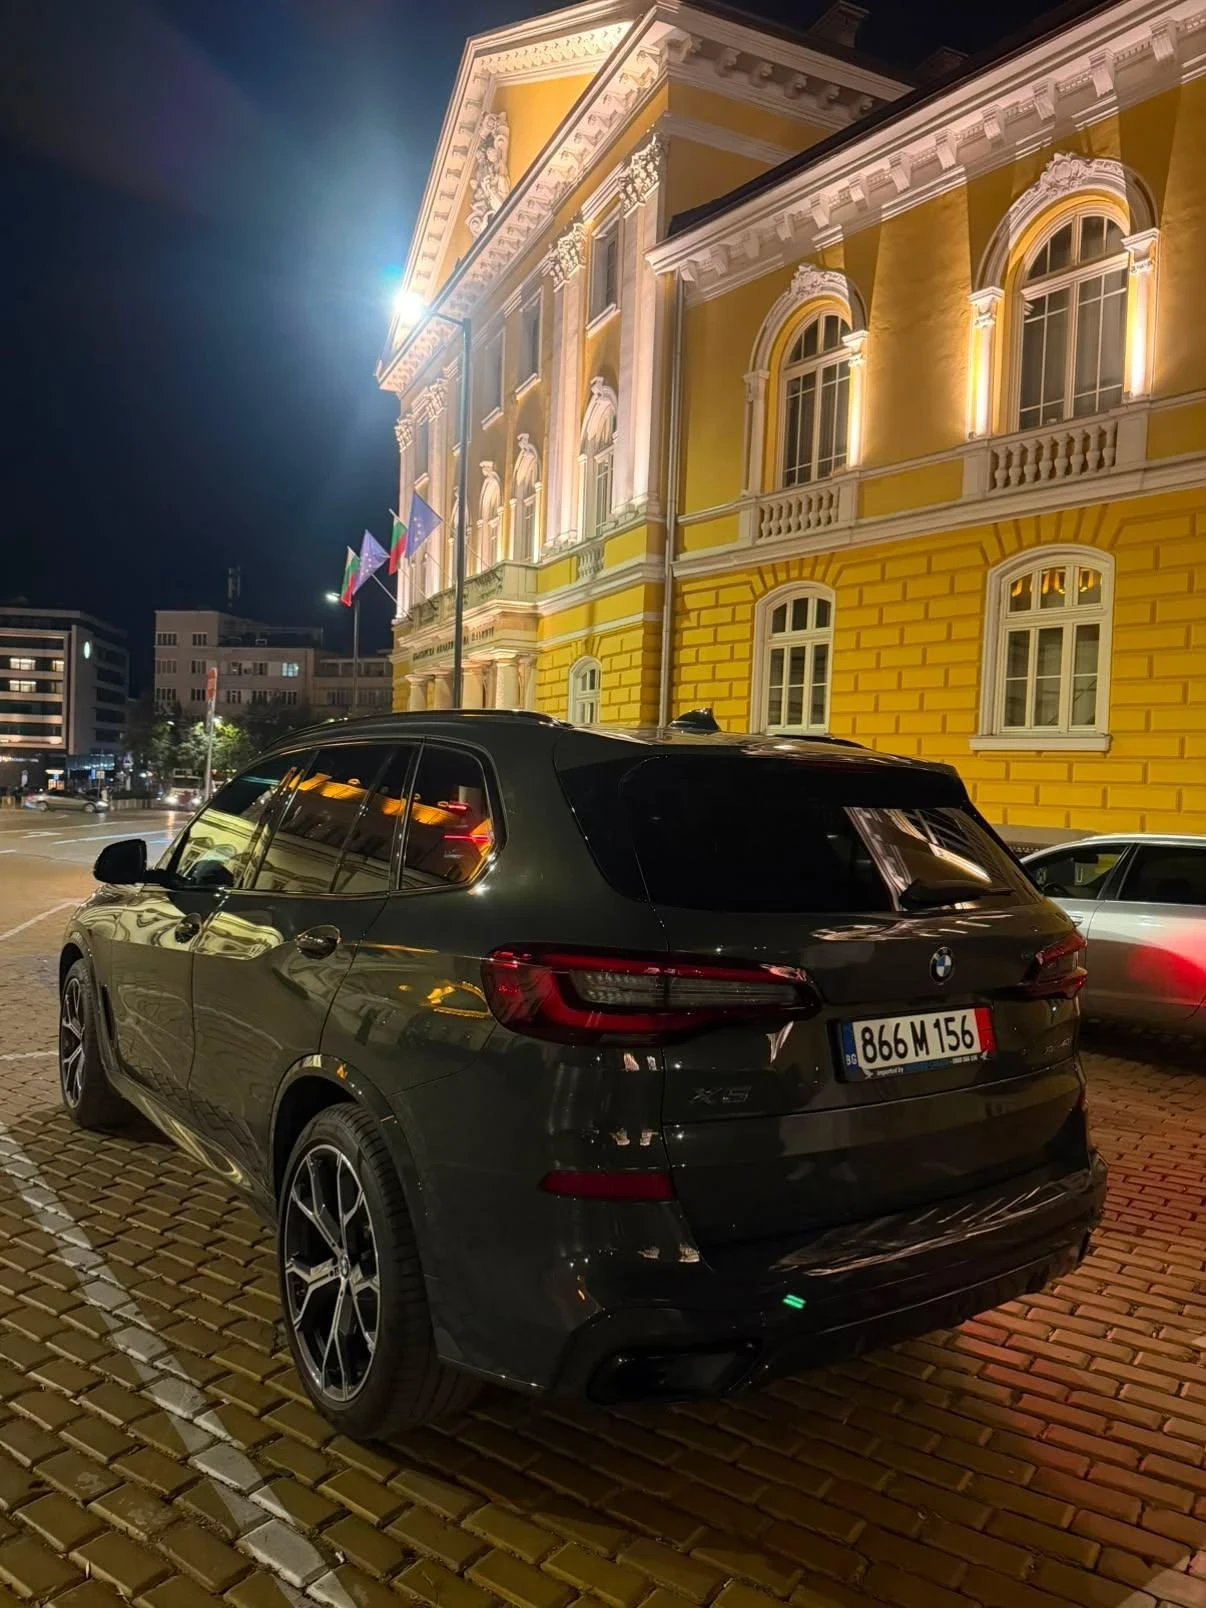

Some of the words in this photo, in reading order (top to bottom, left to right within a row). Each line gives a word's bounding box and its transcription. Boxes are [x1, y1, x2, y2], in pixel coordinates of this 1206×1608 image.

[861, 1023, 908, 1063] 866
[910, 1020, 930, 1057] M
[933, 1015, 975, 1053] 156
[845, 1054, 857, 1066] BG
